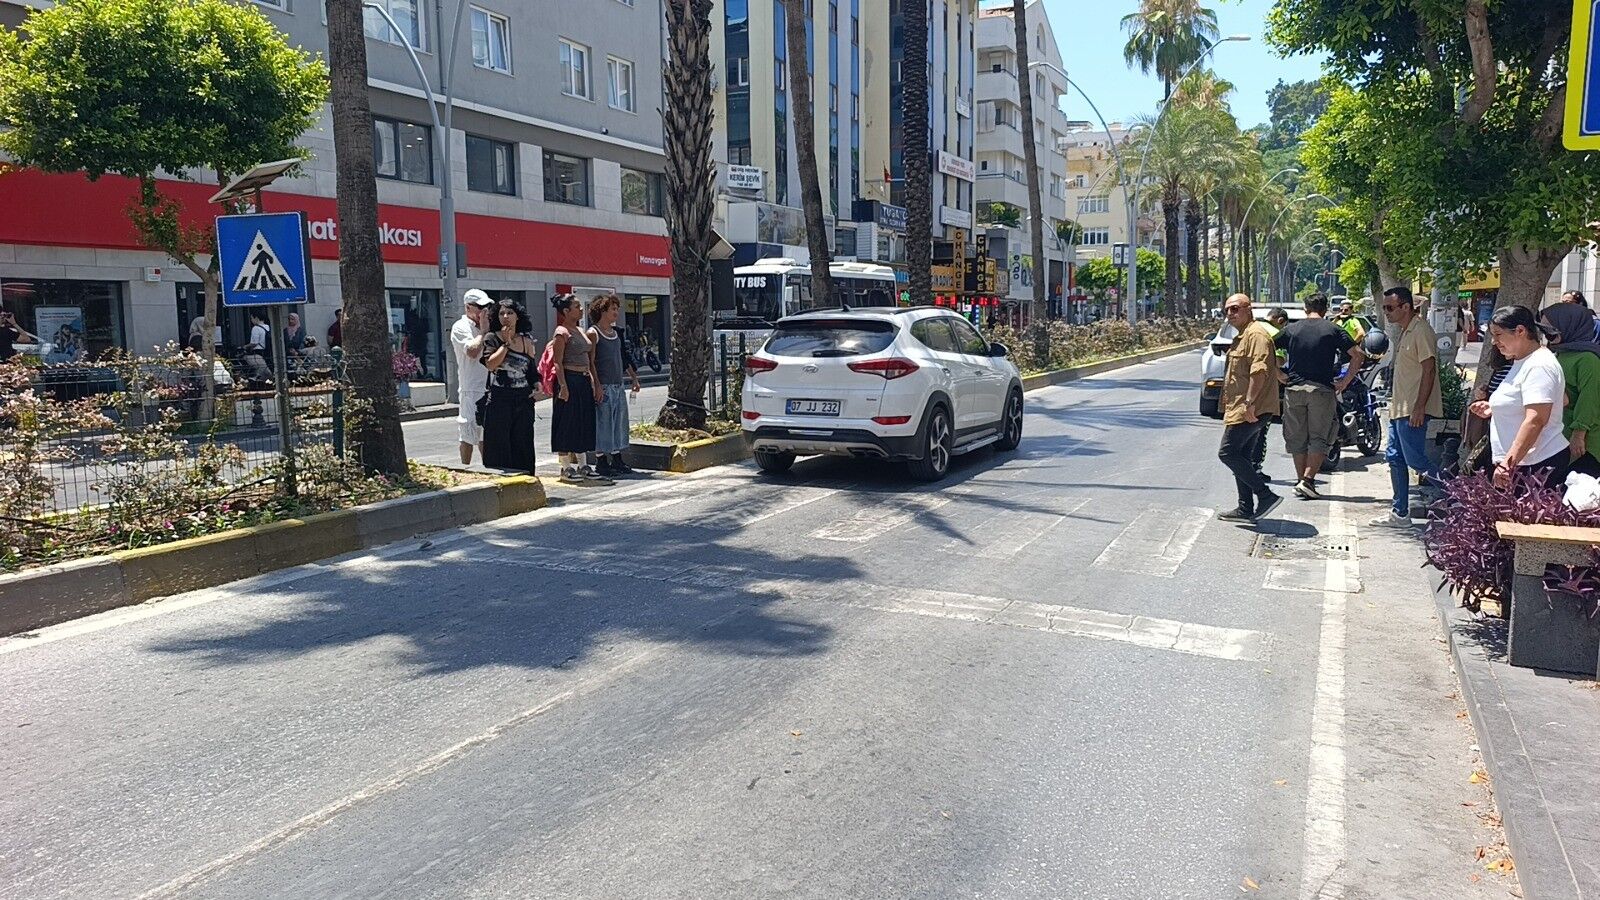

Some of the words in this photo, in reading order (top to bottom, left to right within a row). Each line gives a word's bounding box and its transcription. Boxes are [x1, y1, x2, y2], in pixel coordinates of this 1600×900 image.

[640, 255, 667, 266] Manavgat
[977, 236, 985, 291] CHANGE
[747, 276, 767, 288] BUS
[791, 401, 801, 411] 07
[806, 401, 817, 412] JJ
[821, 401, 838, 412] 232
